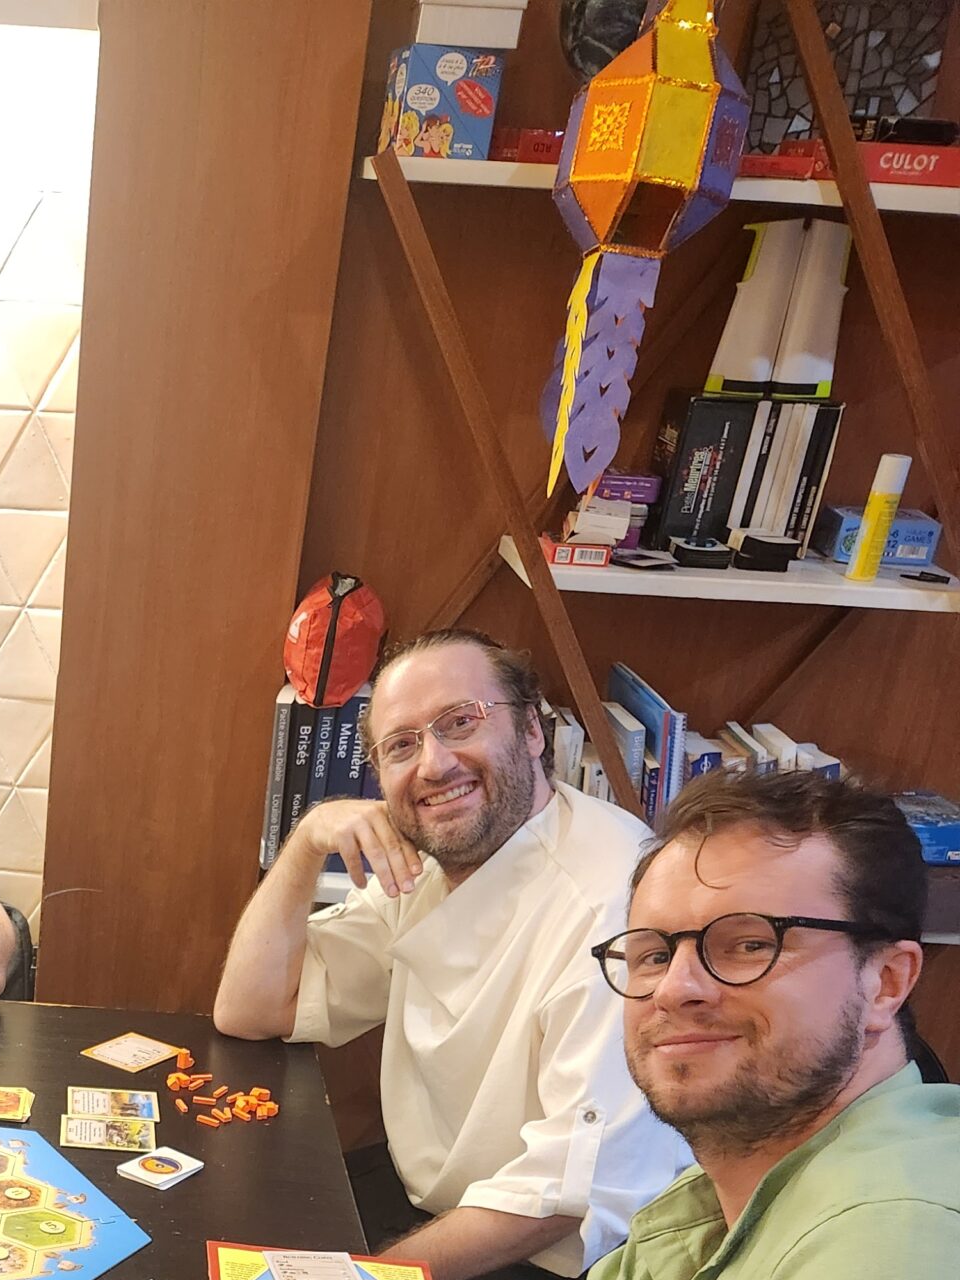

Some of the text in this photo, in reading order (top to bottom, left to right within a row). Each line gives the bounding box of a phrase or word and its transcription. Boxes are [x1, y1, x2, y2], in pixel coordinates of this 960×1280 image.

[879, 152, 940, 172] CULOT
[684, 450, 706, 493] Meurtres
[279, 708, 288, 730] Pacte
[296, 726, 312, 766] Brisés
[314, 716, 334, 778] Into Pieces
[337, 723, 354, 759] Muse
[274, 758, 284, 782] Diable
[270, 794, 281, 824] Louise
[291, 794, 302, 817] Koko
